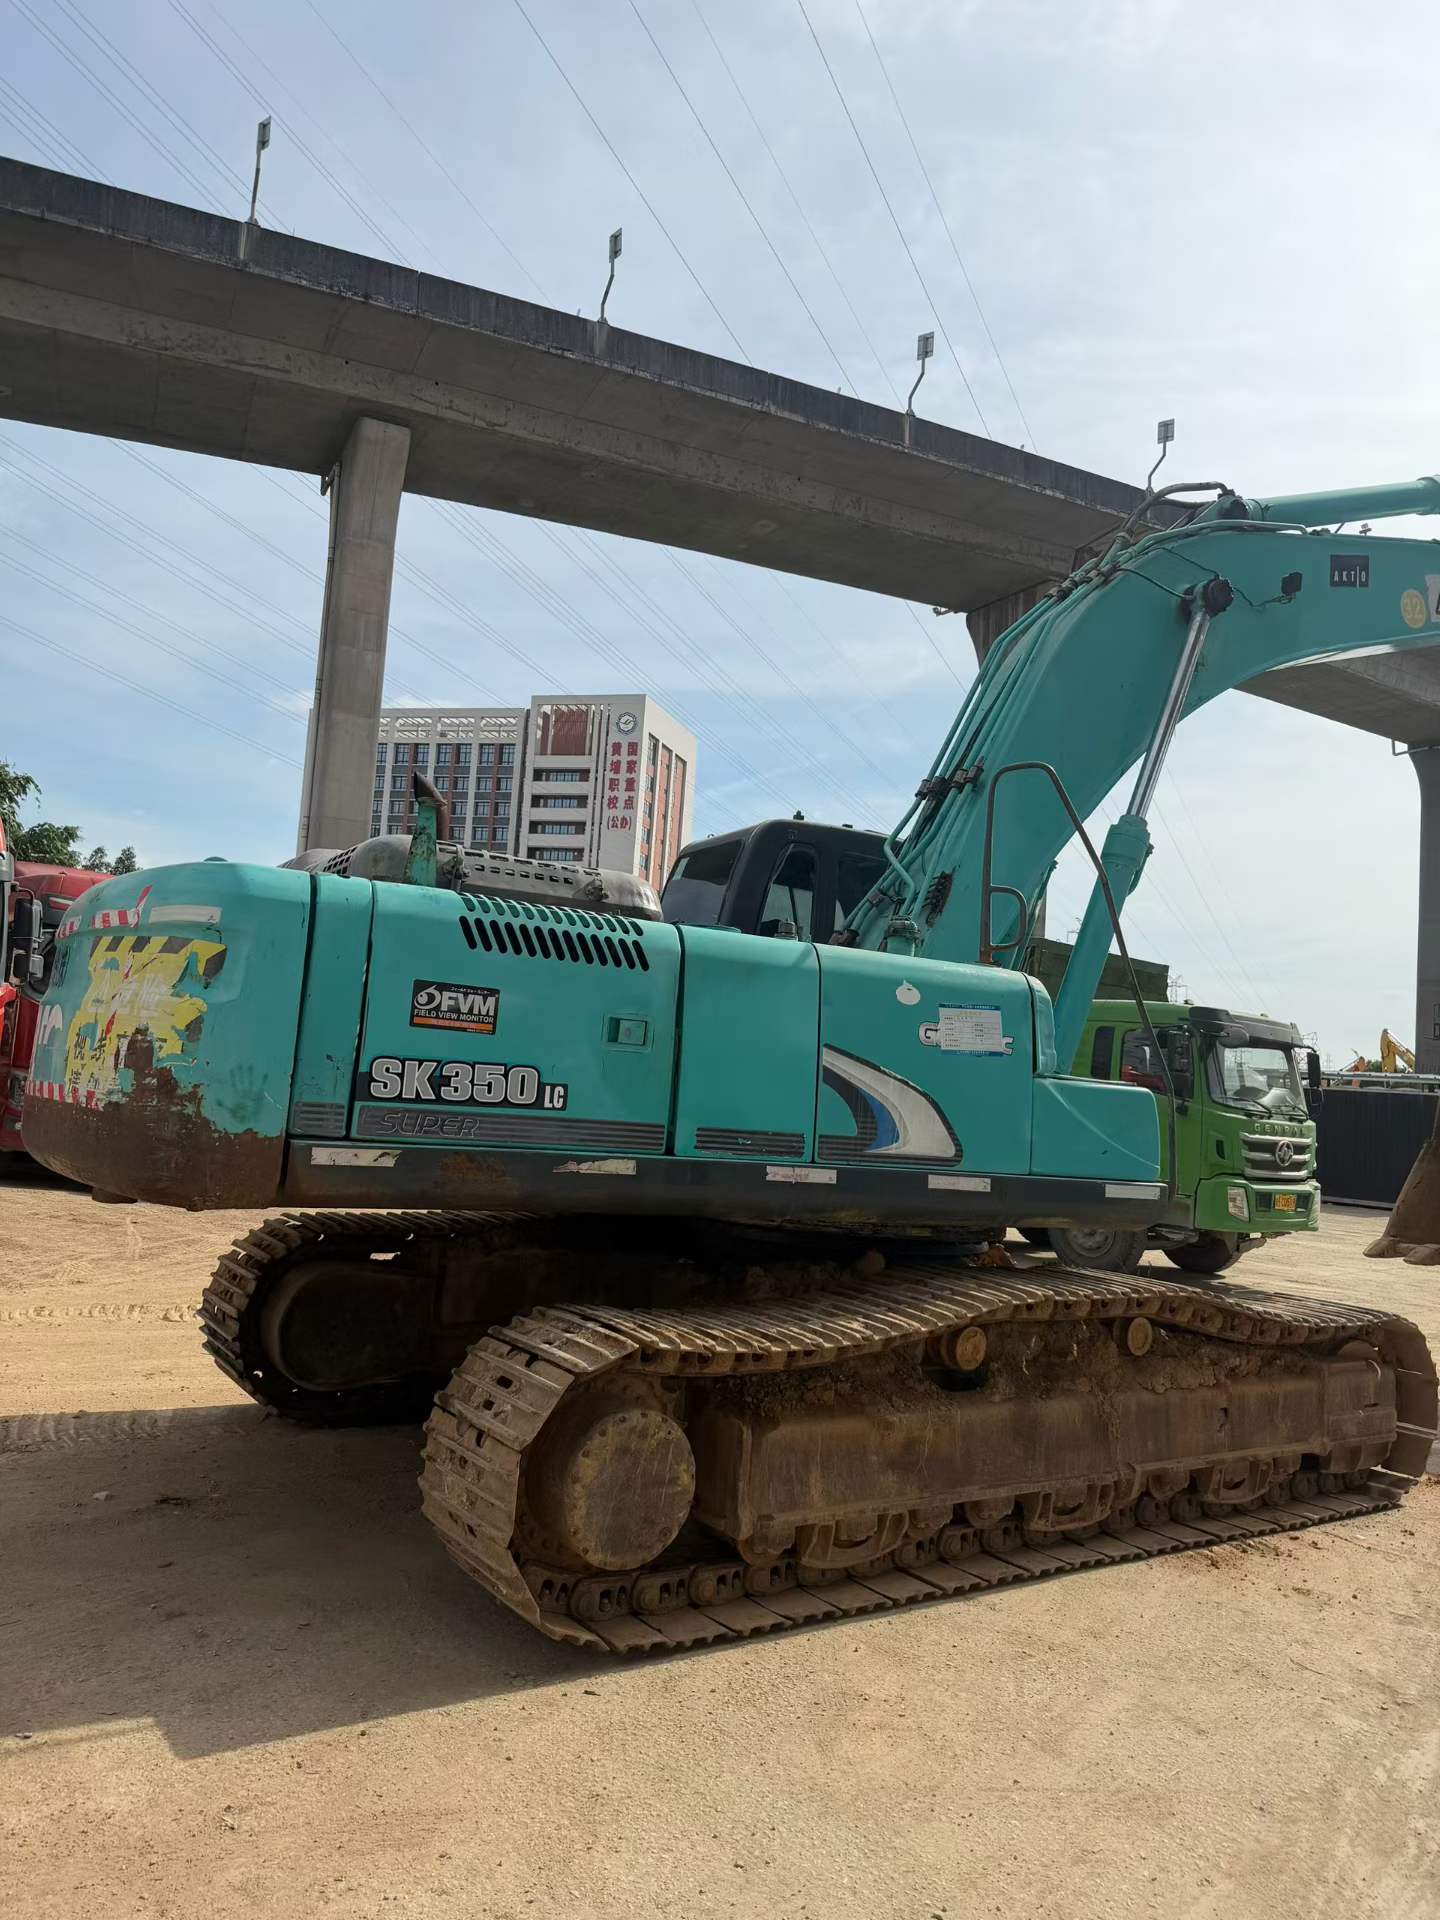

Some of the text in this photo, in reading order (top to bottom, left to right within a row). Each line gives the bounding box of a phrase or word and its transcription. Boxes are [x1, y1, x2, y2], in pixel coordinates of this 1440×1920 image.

[624, 742, 638, 809] 国家重点
[414, 1009, 494, 1023] FIELD VIEW MONITOR
[441, 991, 496, 1016] FVM
[544, 1085, 564, 1108] LC
[377, 1112, 480, 1137] SUPER
